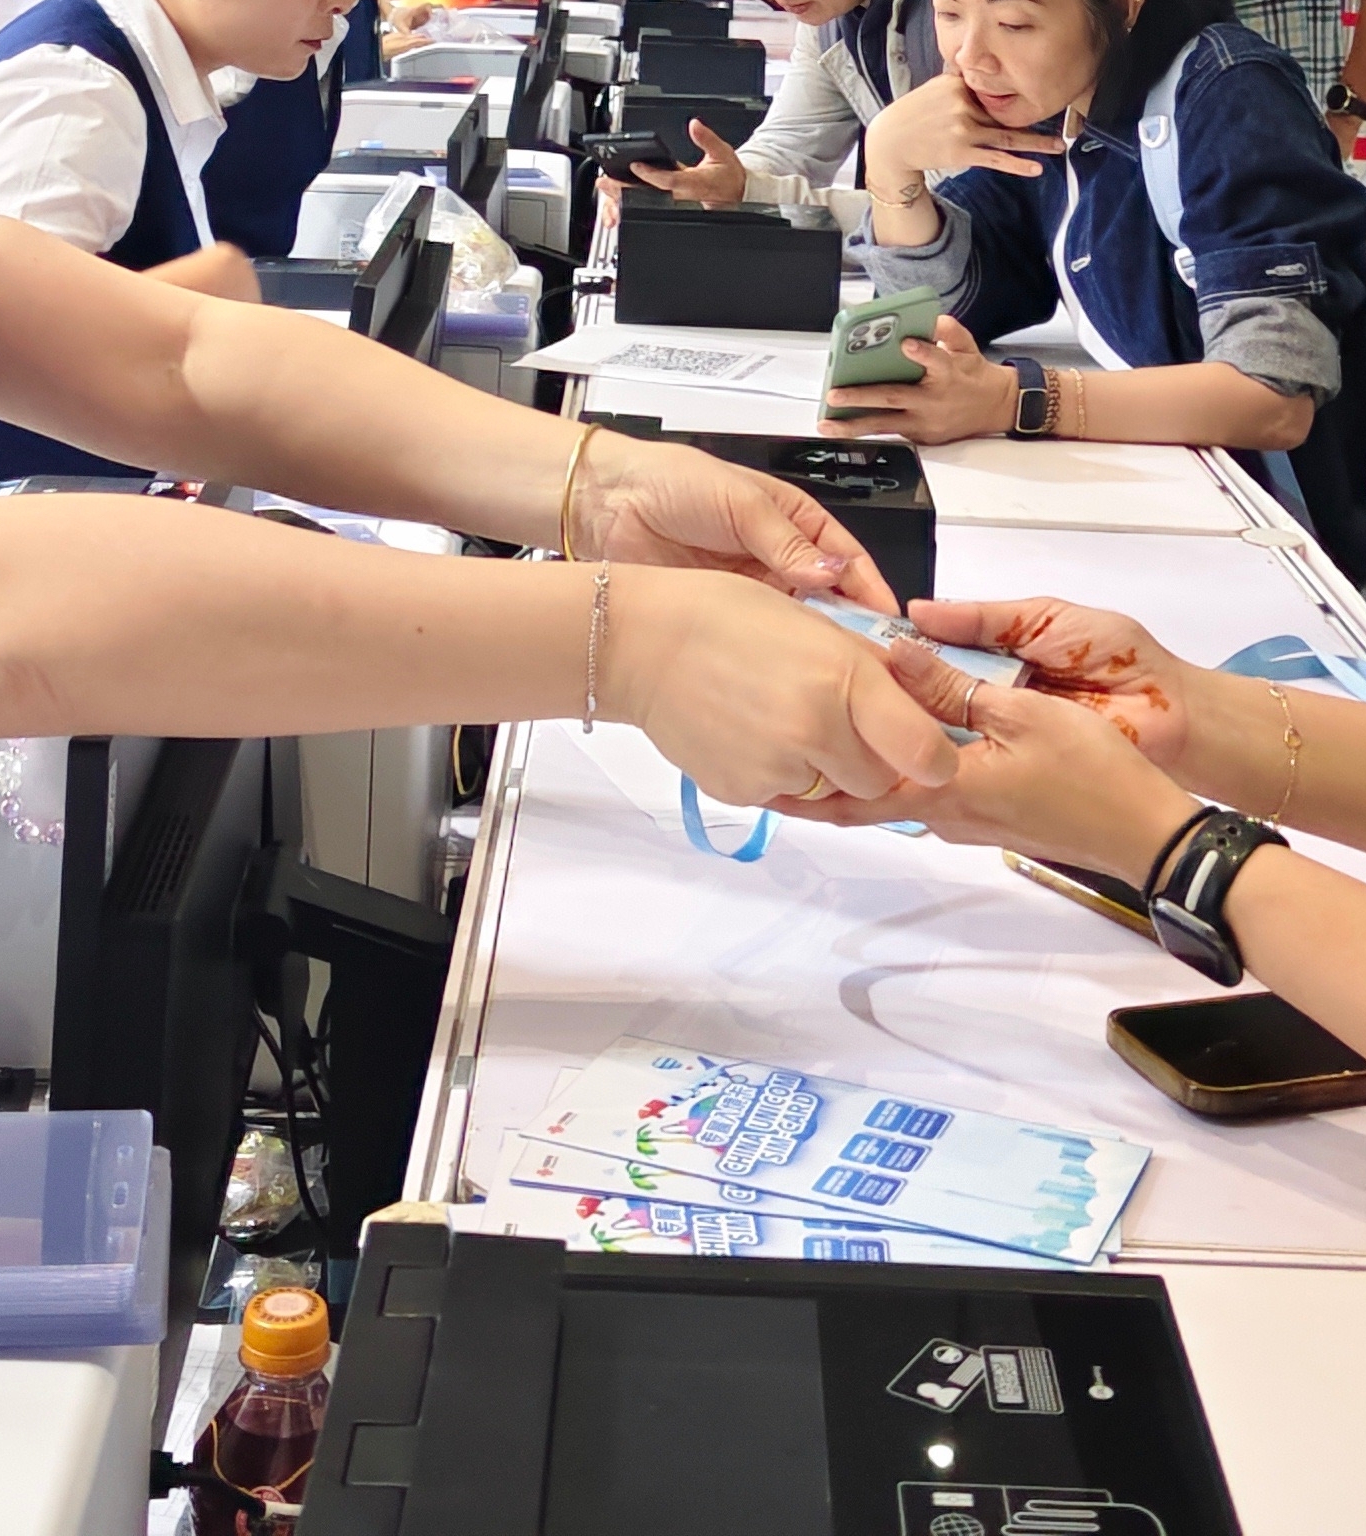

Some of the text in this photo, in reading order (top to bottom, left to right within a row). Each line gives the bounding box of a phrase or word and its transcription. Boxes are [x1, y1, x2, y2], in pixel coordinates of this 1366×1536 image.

[722, 1132, 765, 1173] CHINA
[748, 1073, 802, 1128] UNICOM
[696, 1214, 728, 1257] HINA
